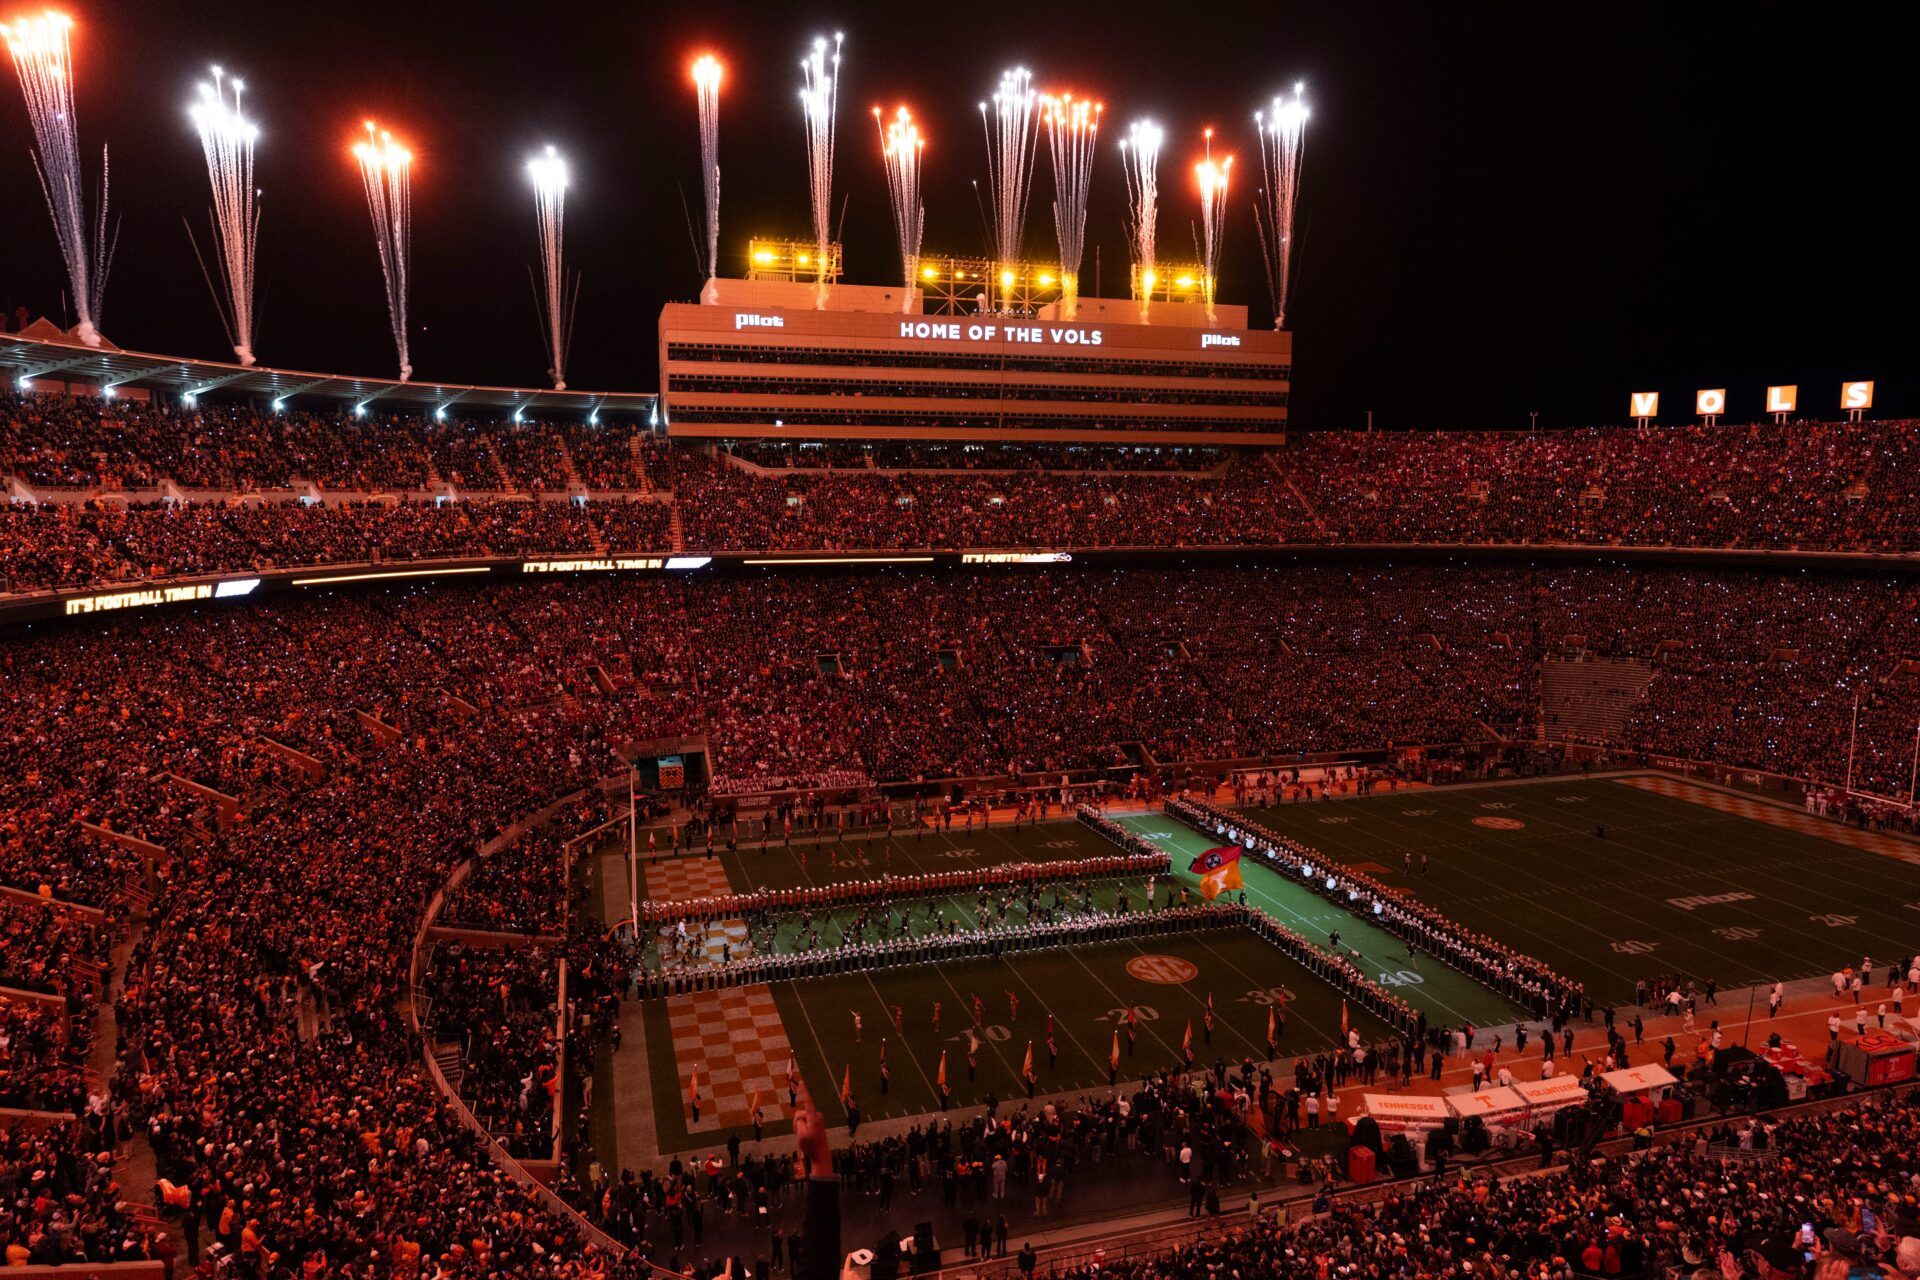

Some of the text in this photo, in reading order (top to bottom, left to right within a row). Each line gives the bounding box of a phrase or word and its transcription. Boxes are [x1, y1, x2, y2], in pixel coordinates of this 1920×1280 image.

[901, 322, 1103, 345] HOME OF THE VOLS
[524, 559, 662, 573] IT'S FOOTBALL TIME IN
[66, 585, 212, 615] IT'S FOOTBALL TIME IN
[1656, 760, 1697, 771] NISSAN
[1808, 913, 1858, 927] 20
[1711, 926, 1761, 941] 30
[1609, 940, 1655, 955] 40
[1132, 957, 1194, 982] SEC
[1378, 970, 1425, 987] 40
[1255, 986, 1297, 1006] 30
[1107, 1005, 1160, 1025] 20
[959, 1025, 1012, 1045] 10
[1377, 1101, 1436, 1111] TENNESSEE
